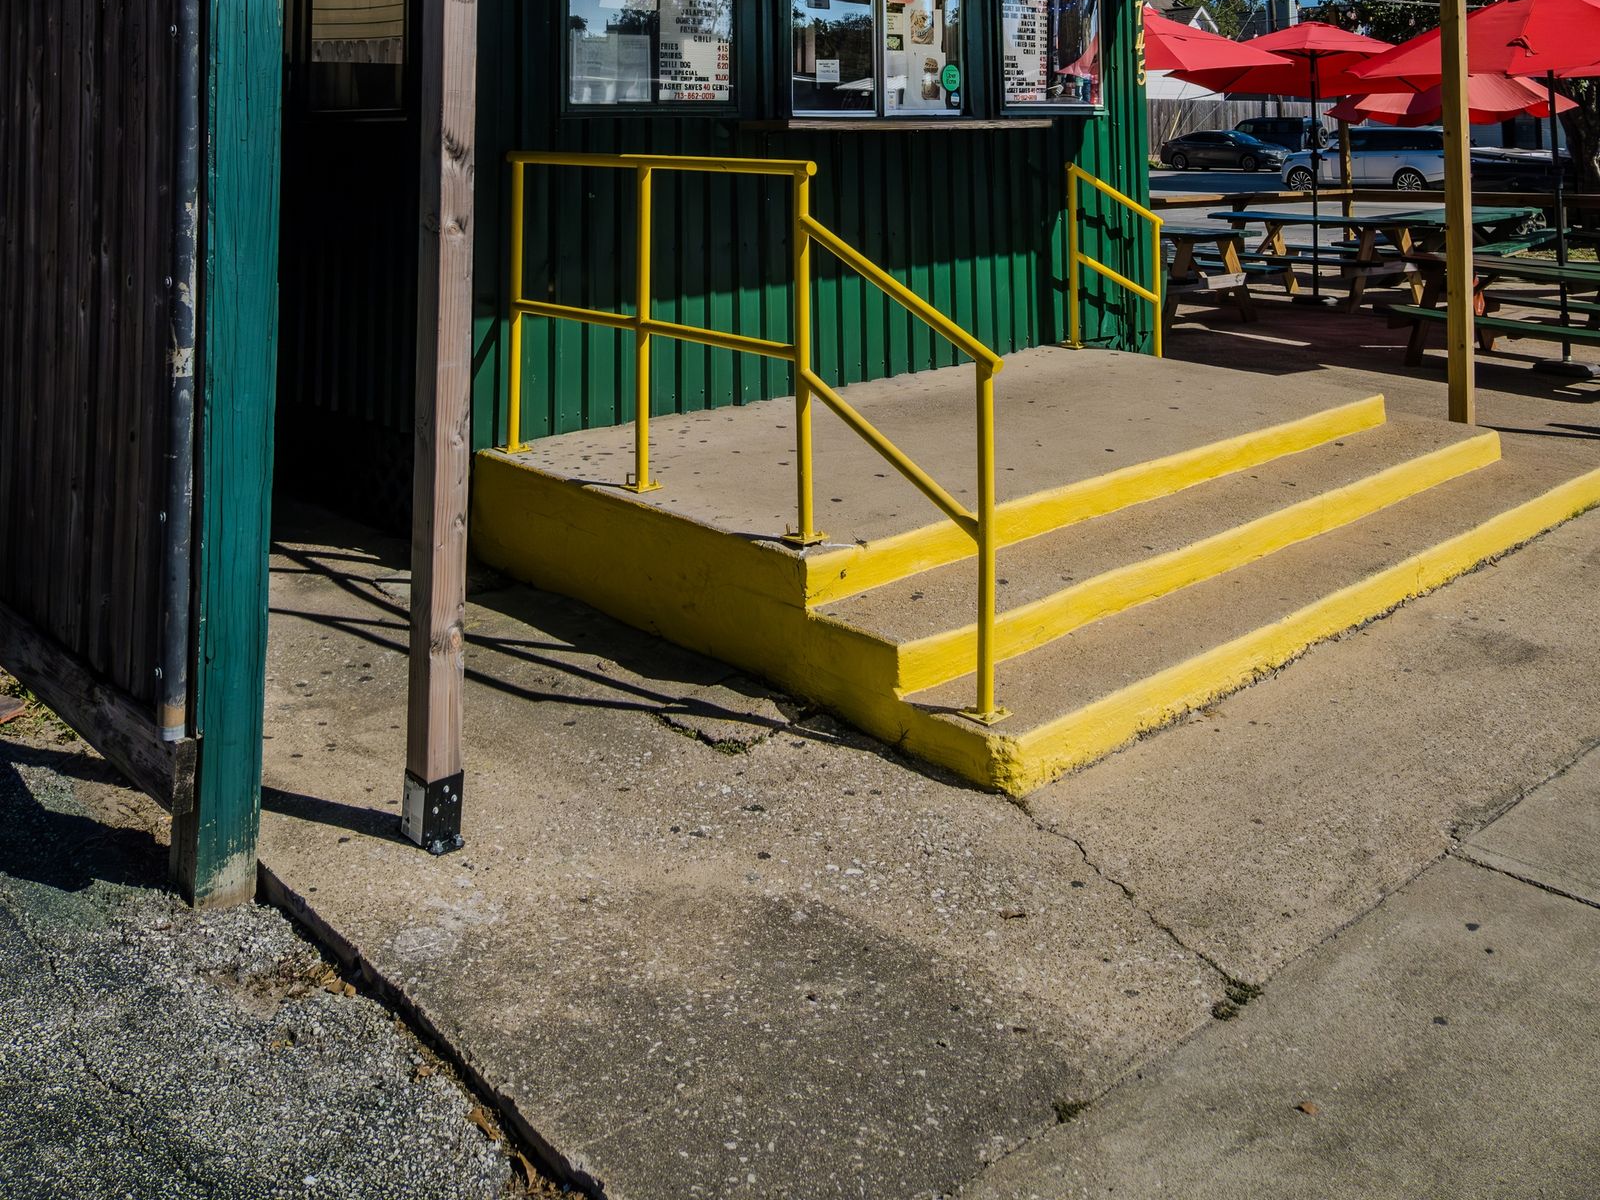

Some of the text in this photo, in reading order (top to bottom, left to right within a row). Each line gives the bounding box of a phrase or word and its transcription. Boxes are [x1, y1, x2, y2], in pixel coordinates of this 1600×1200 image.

[693, 35, 712, 43] CHILI
[1135, 0, 1147, 86] 745
[660, 42, 679, 50] FRIES
[660, 60, 677, 69] CHILI
[680, 61, 691, 69] DOG
[660, 82, 682, 91] BASKET
[684, 83, 703, 91] SAVES
[703, 83, 711, 91] 40
